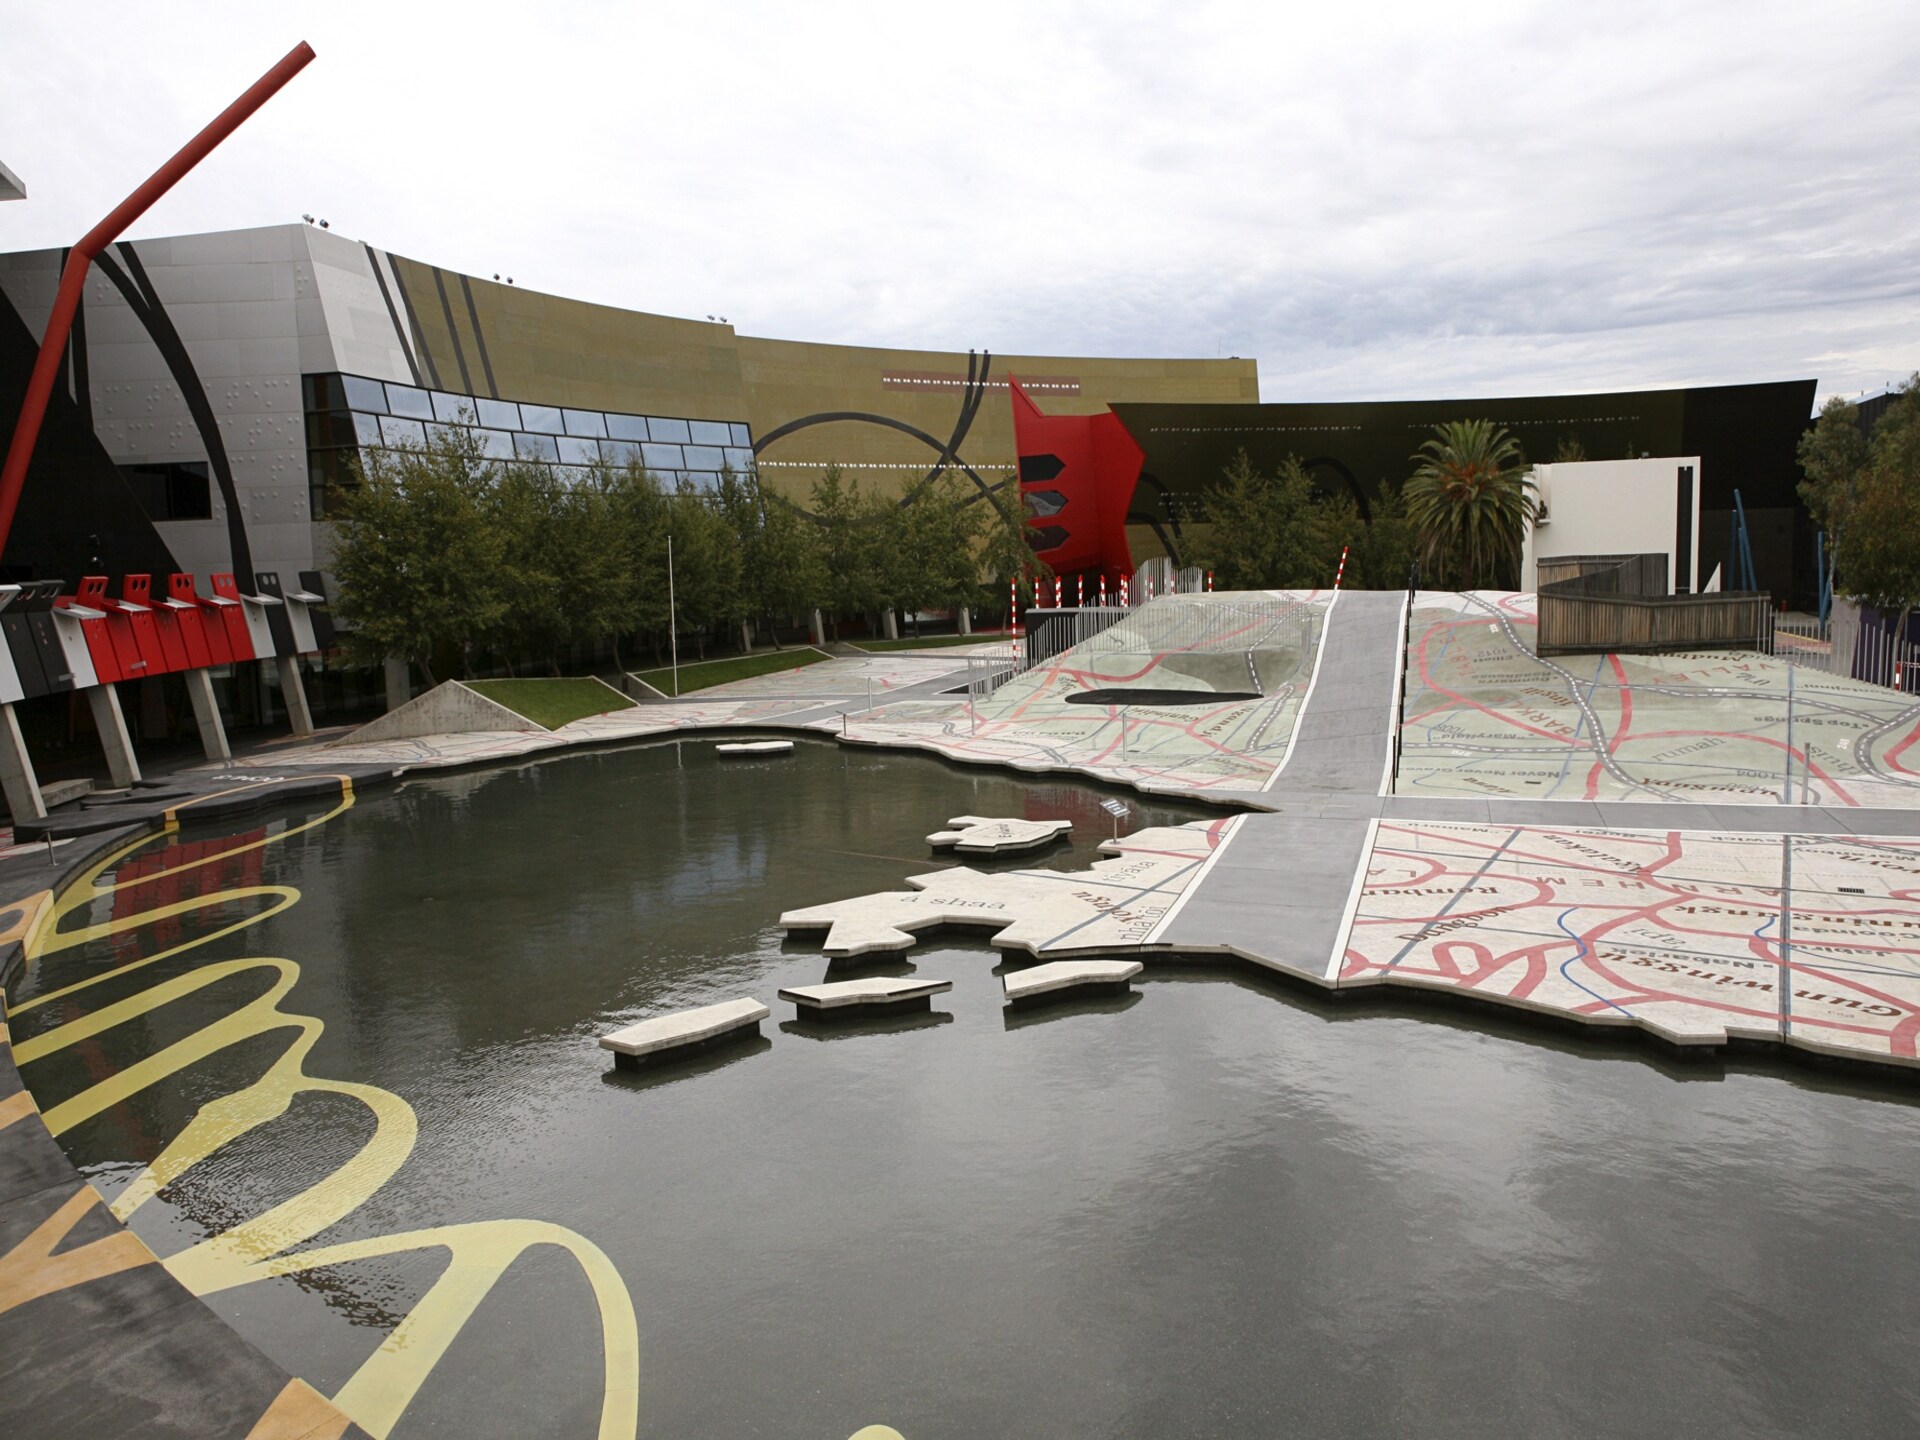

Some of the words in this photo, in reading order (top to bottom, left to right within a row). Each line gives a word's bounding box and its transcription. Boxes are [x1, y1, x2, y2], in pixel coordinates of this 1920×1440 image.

[1830, 721, 1863, 729] Top
[1652, 736, 1727, 762] rumah
[1809, 745, 1862, 775] thuis
[1737, 769, 1778, 779] 1004
